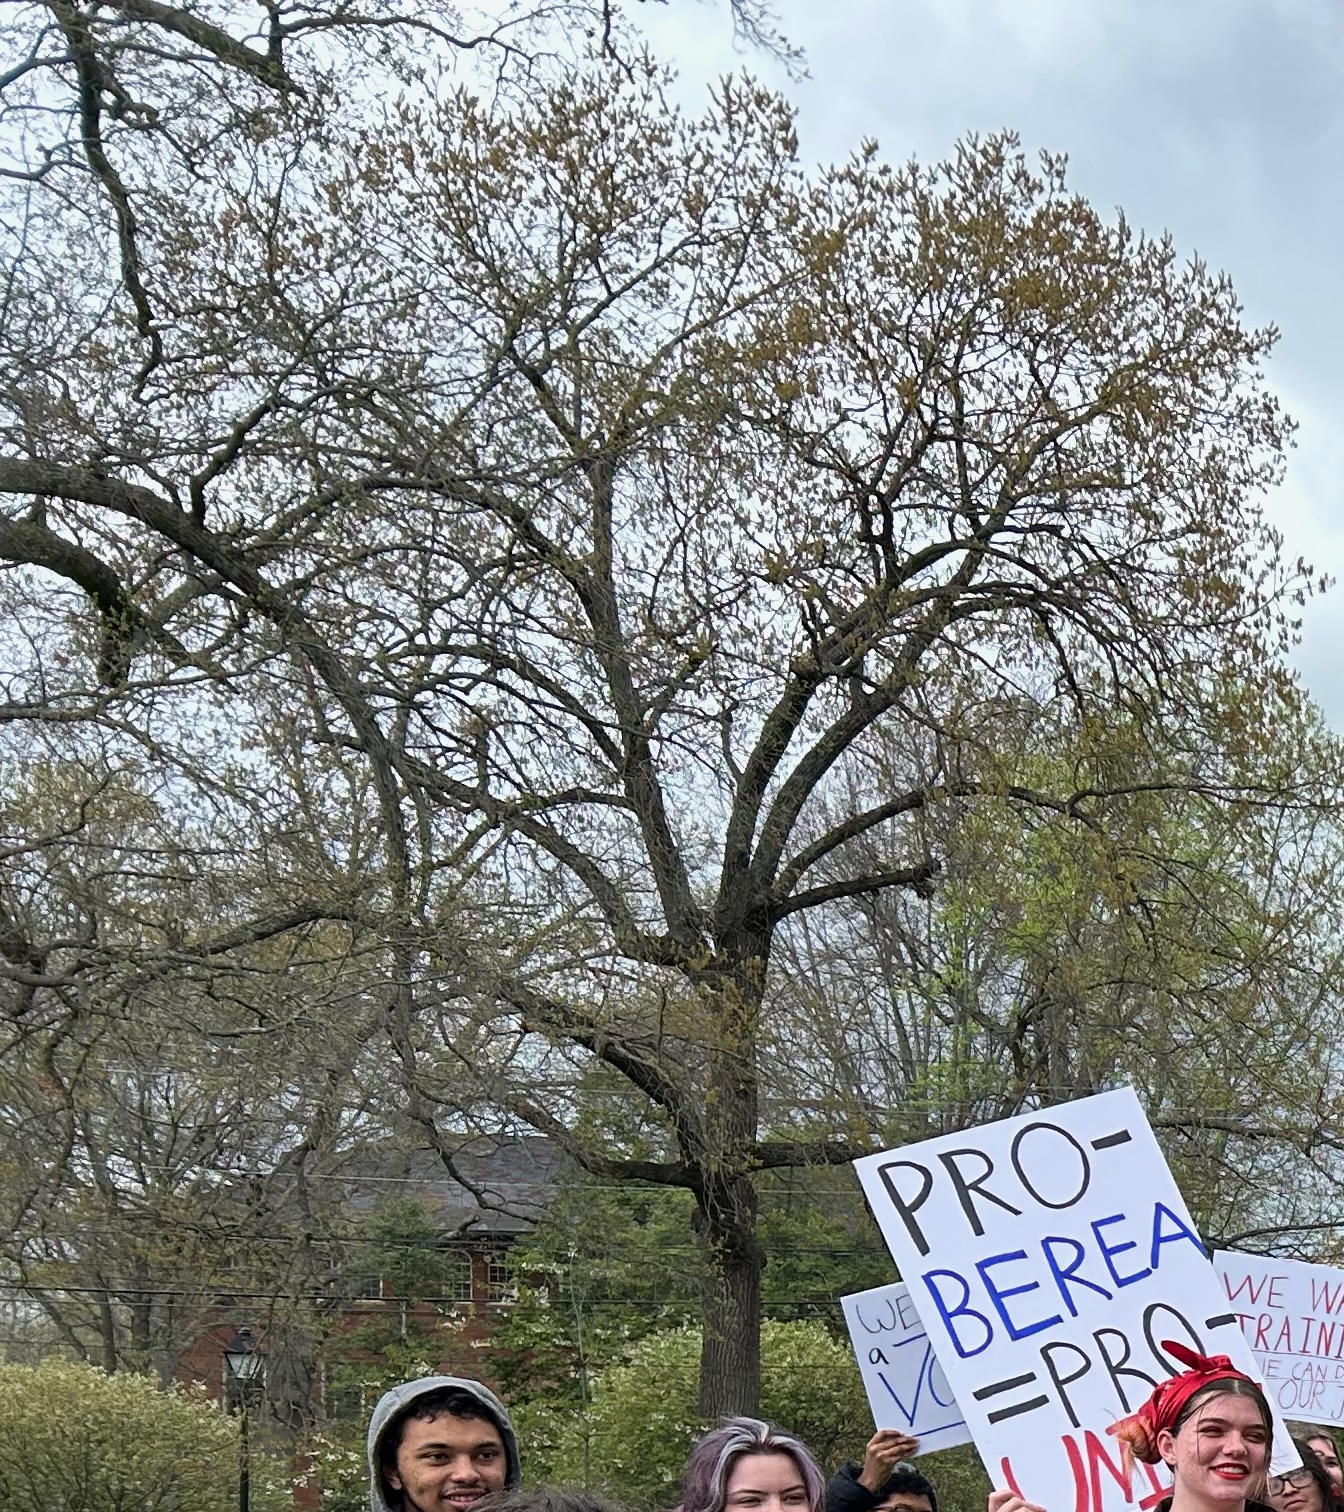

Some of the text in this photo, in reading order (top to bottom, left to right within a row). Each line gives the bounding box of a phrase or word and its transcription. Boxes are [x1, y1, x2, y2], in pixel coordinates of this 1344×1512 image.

[877, 1120, 1133, 1256] PRO-
[922, 1201, 1210, 1359] BEREA
[1223, 1272, 1288, 1309] WE
[1292, 1361, 1327, 1381] CAN
[1278, 1378, 1326, 1411] OUR
